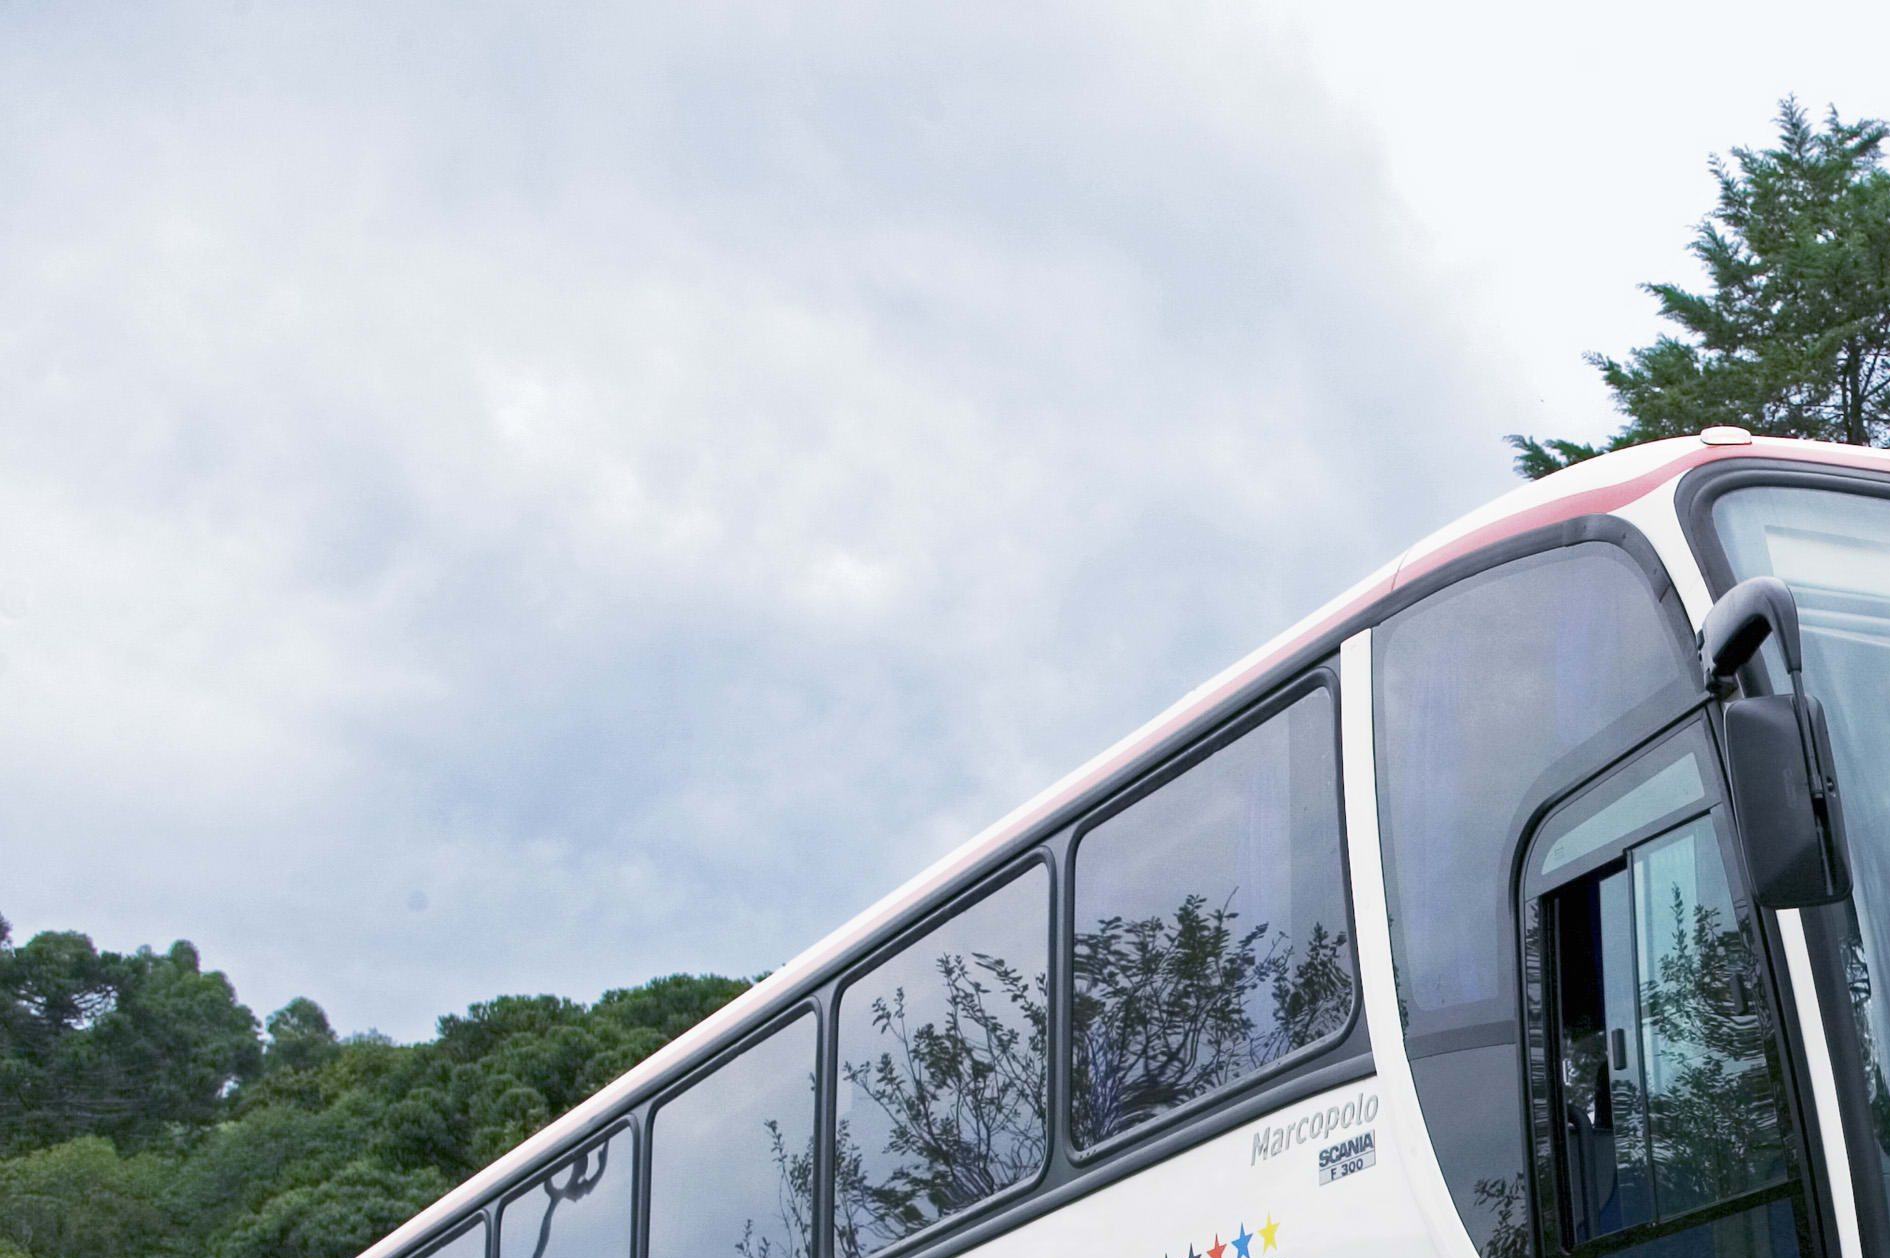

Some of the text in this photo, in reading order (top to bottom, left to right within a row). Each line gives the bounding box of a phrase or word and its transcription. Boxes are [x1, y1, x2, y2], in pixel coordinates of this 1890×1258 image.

[1251, 1092, 1379, 1167] Marcopolo
[1319, 1133, 1374, 1168] SCANIA
[1330, 1158, 1364, 1181] F 300
